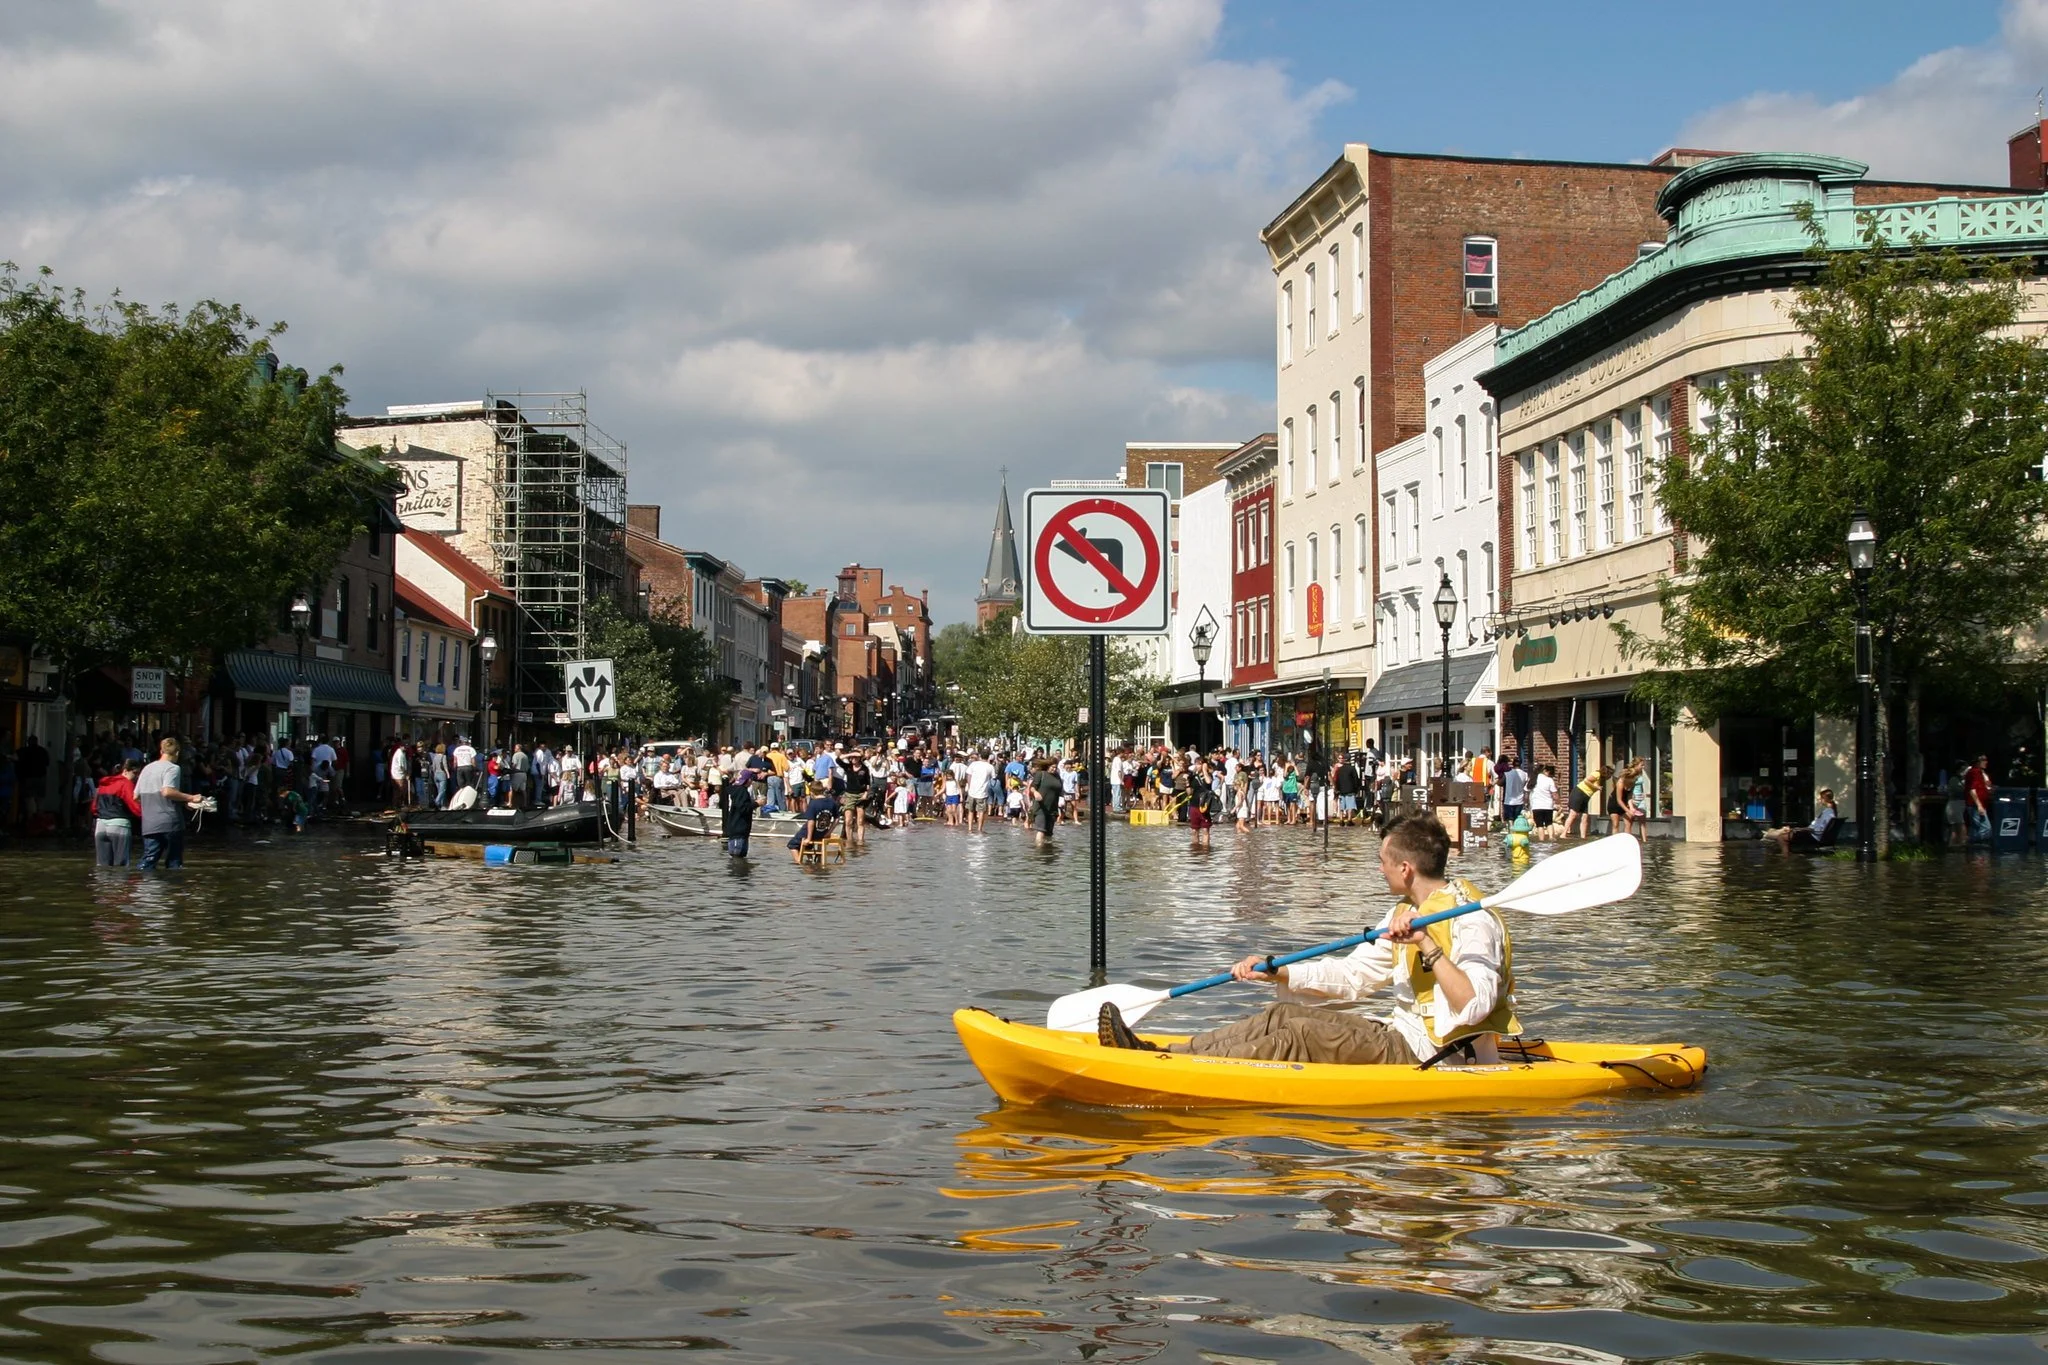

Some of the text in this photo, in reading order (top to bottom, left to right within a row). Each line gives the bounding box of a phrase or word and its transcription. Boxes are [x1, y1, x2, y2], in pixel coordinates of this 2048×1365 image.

[1697, 196, 1770, 223] BUILDING
[399, 467, 429, 491] NS
[398, 489, 453, 515] rniture
[135, 671, 162, 681] SNOW
[133, 690, 163, 701] ROUTE
